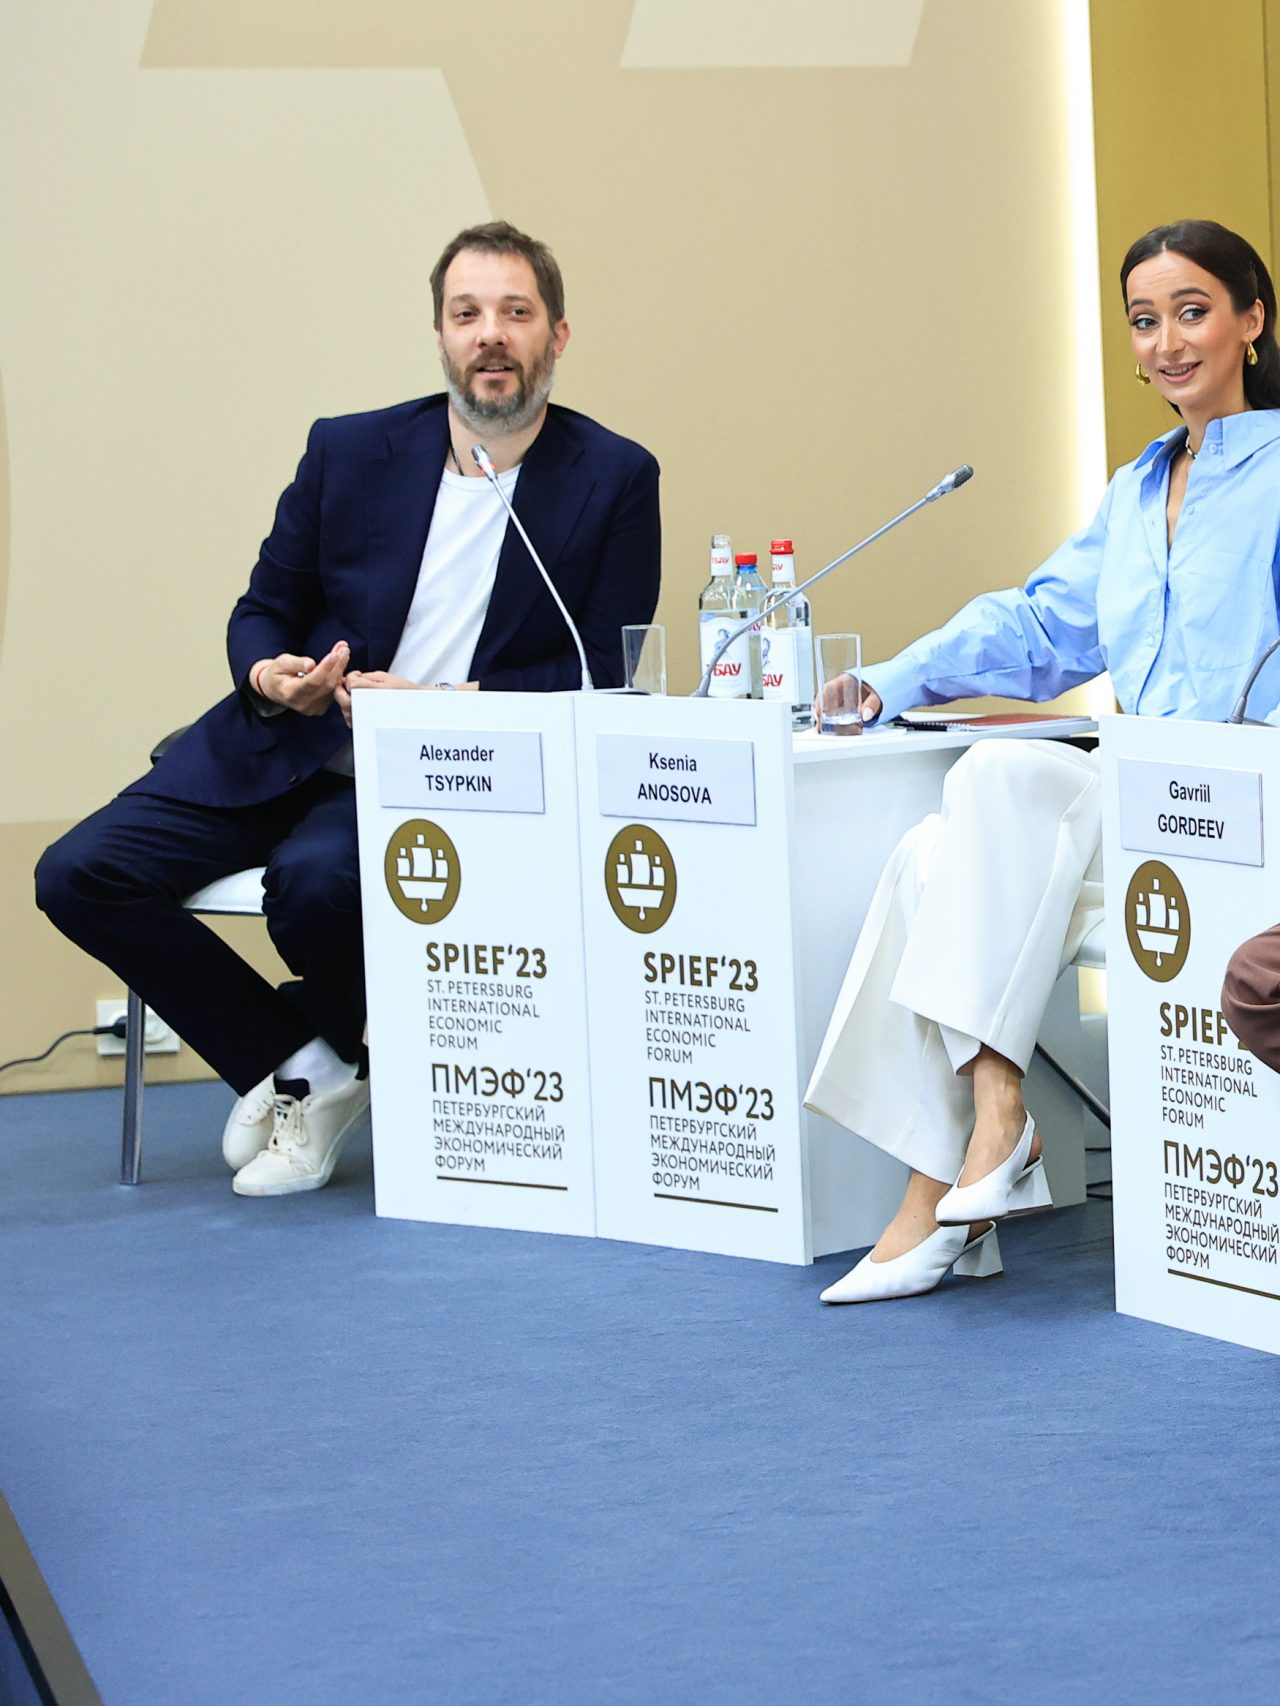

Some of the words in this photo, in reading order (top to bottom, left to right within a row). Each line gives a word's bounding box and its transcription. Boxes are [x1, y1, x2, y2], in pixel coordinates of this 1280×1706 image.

[706, 663, 742, 677] БАУ
[419, 744, 494, 762] Alexander
[649, 752, 697, 772] Ksenia
[424, 775, 492, 792] TSYPKIN
[638, 783, 712, 804] ANOSOVA
[1169, 780, 1210, 803] Gavriil
[1158, 813, 1224, 840] GORDEEV
[427, 979, 445, 994] ST.
[448, 980, 533, 999] PETERSBURG
[428, 997, 540, 1018] INTERNATIONAL
[645, 990, 662, 1005] ST.
[664, 993, 745, 1013] PETERSBURG
[429, 1015, 503, 1034] ECONOMIC
[645, 1009, 751, 1032] INTERNATIONAL
[1160, 1001, 1250, 1051] SPIEF
[430, 1034, 478, 1050] FORUM
[646, 1027, 716, 1048] ECONOMIC
[647, 1046, 693, 1064] FORUM
[1160, 1045, 1176, 1062] ST.
[1178, 1047, 1252, 1076] PETERSBURG
[1161, 1065, 1258, 1098] INTERNATIONAL
[1162, 1086, 1225, 1112] ECONOMIC
[433, 1100, 546, 1122] ПЕТЕРБУРГСКИЙ
[1162, 1107, 1204, 1129] FORUM
[433, 1118, 565, 1142] МЕЖДУНАРОДНЫЙ
[650, 1115, 757, 1140] ПЕТЕРБУРГСКИЙ
[434, 1136, 562, 1160] ЭКОНОМИЧЕСКИЙ
[651, 1134, 776, 1162] МЕЖДУНАРОДНЫЙ
[435, 1155, 485, 1172] ФОРУМ
[652, 1152, 773, 1181] ЭКОНОМИЧЕСКИЙ
[652, 1172, 700, 1190] ФОРУМ
[1165, 1182, 1262, 1219] ПЕТЕРБУРГСКИЙ
[1165, 1203, 1280, 1244] МЕЖДУНАРОДНЫЙ
[1166, 1223, 1277, 1265] ЭКОНОМИЧЕСКИЙ
[1166, 1245, 1209, 1270] ФОРУМ
